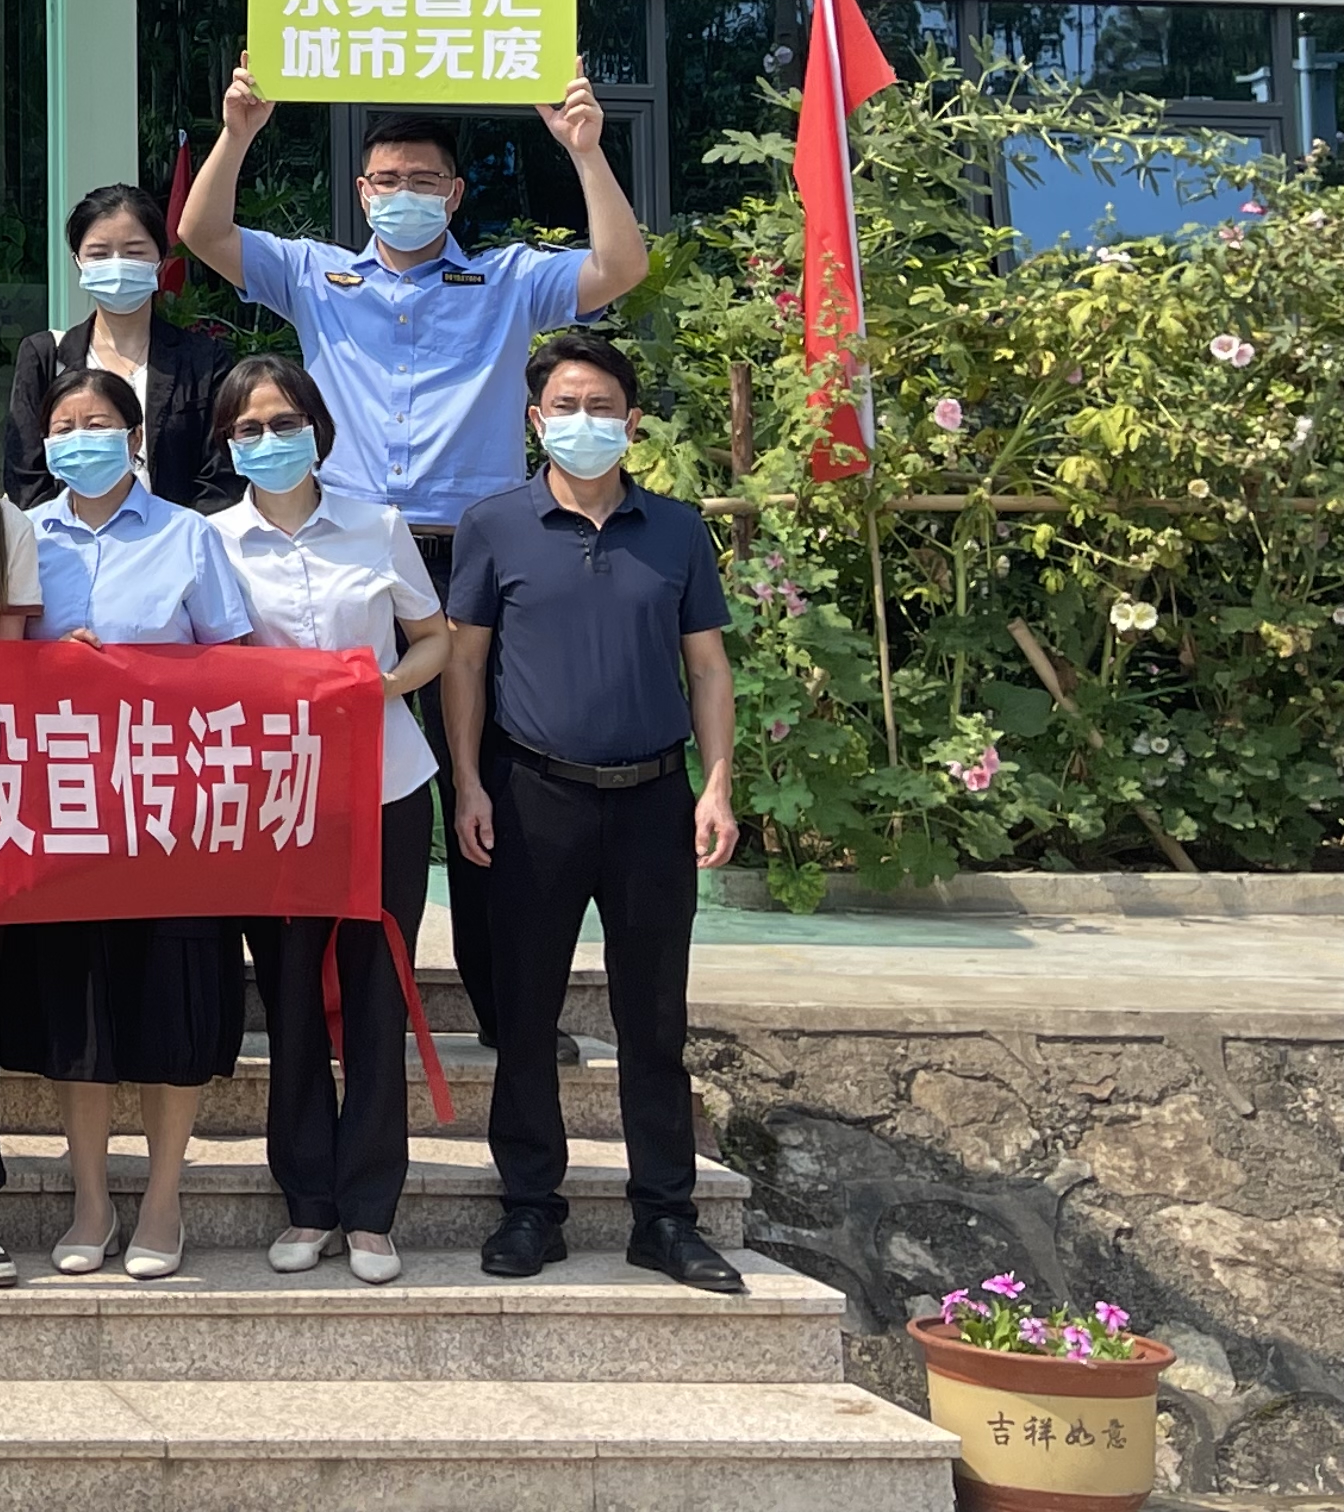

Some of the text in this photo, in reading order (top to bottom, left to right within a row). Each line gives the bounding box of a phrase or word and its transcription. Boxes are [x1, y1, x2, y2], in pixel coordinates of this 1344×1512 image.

[281, 26, 543, 81] 城市无废
[986, 1410, 1128, 1452] 吉祥如意
